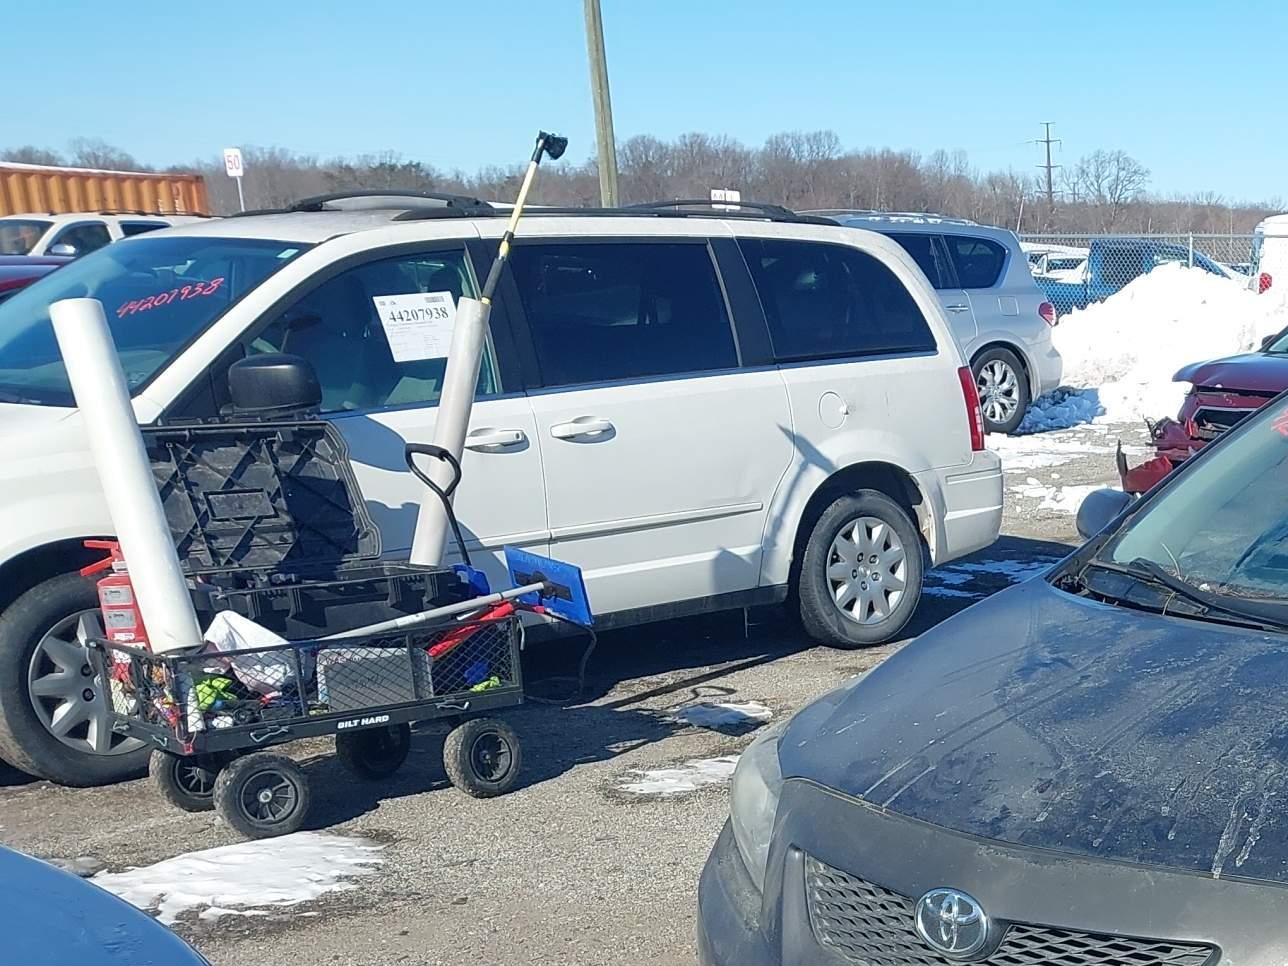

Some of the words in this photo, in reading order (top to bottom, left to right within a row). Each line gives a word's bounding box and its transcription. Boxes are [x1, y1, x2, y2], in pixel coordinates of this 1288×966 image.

[226, 154, 240, 170] 50
[116, 277, 225, 318] 44207938
[389, 306, 449, 322] 44207938
[361, 715, 390, 726] HARD
